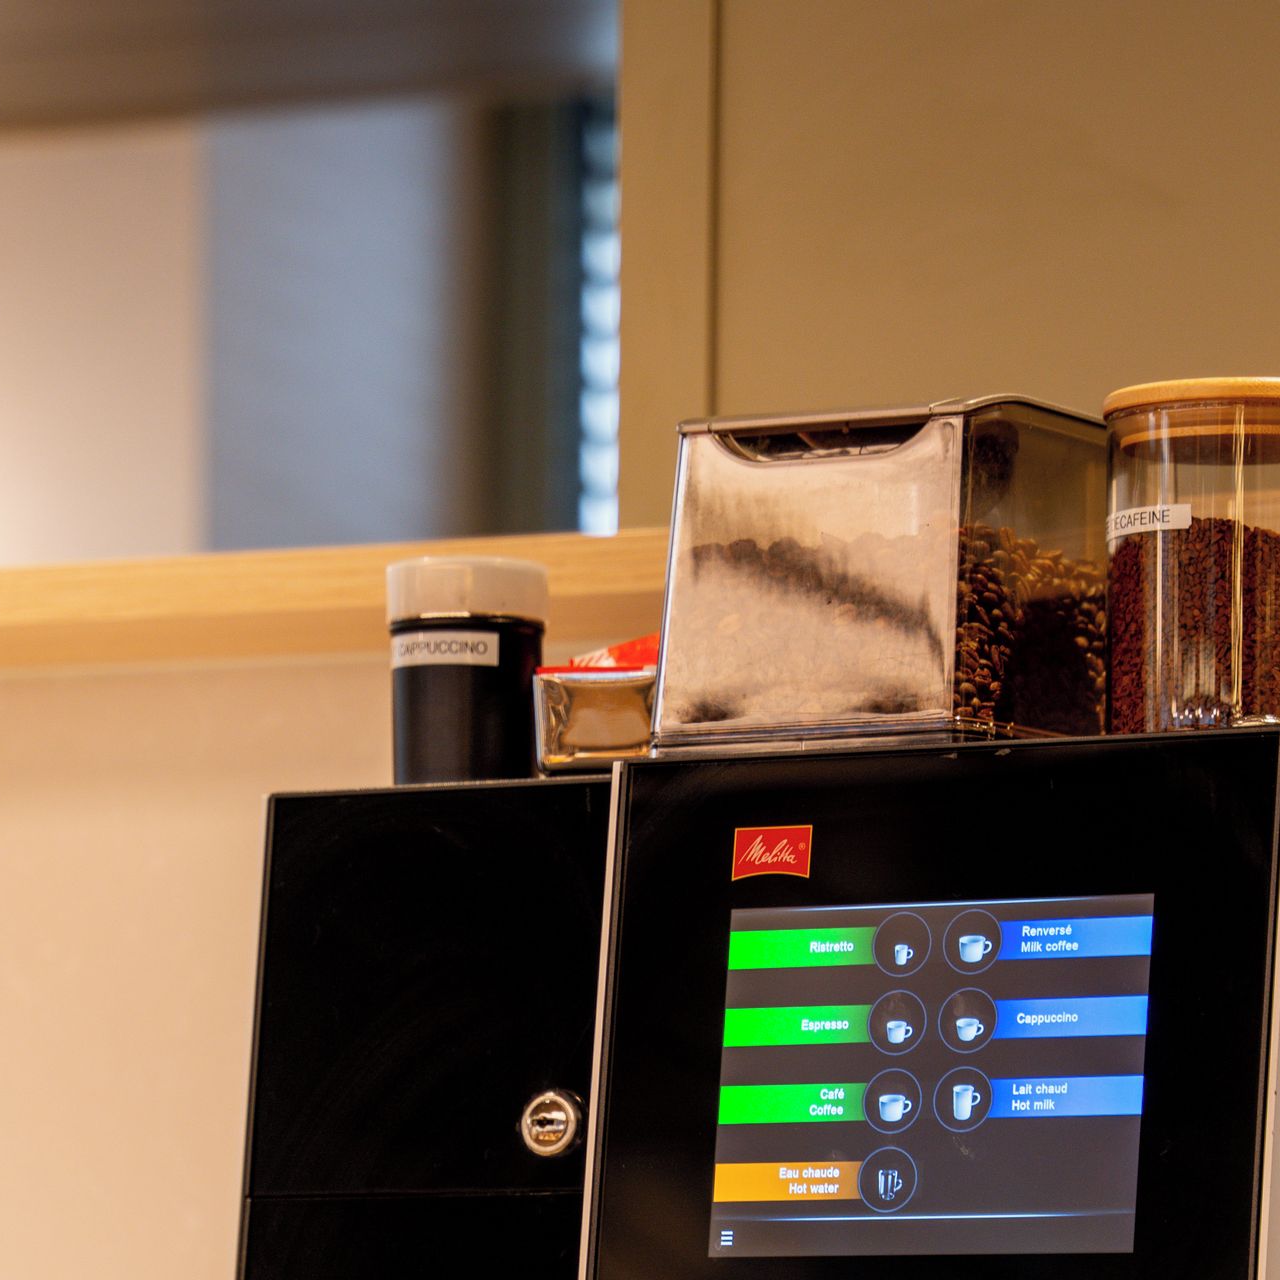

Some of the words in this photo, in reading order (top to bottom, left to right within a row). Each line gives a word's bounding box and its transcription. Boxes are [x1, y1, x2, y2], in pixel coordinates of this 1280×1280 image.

[1022, 924, 1072, 937] Renversé
[809, 941, 854, 953] Ristretto
[1021, 941, 1042, 953] Milk
[1045, 940, 1079, 952] coffee
[1016, 1011, 1078, 1026] Cappuccino
[801, 1018, 849, 1033] Espresso
[820, 1088, 845, 1100] Café
[1012, 1083, 1032, 1095] Lait
[1035, 1082, 1068, 1094] chaud
[809, 1104, 843, 1116] Coffee
[1011, 1099, 1030, 1111] Hot
[1033, 1099, 1055, 1110] milk
[779, 1167, 799, 1179] Eau
[802, 1166, 840, 1178] chaude
[789, 1183, 807, 1194] Hot
[810, 1183, 839, 1194] water
